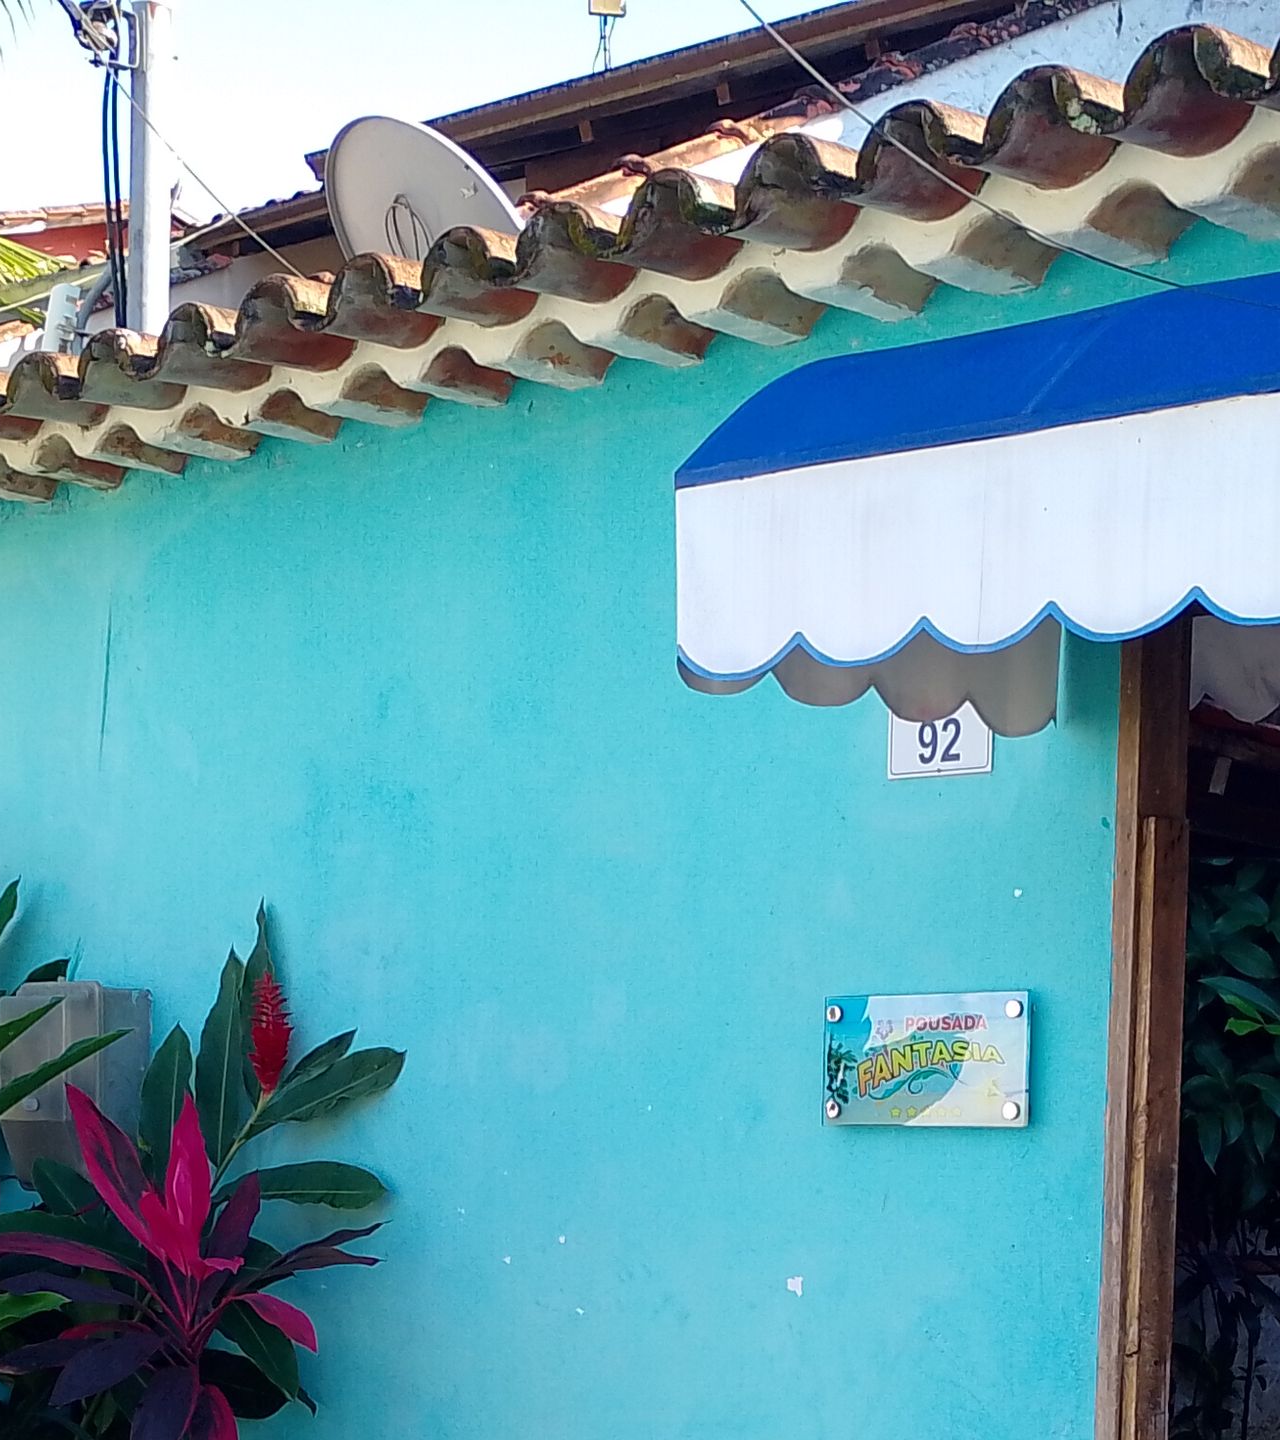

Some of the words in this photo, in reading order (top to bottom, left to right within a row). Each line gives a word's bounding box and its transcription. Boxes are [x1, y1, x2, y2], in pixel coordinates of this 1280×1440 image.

[918, 717, 961, 765] 92
[904, 1013, 988, 1032] POUSADA
[856, 1039, 1006, 1099] FANTASIA
